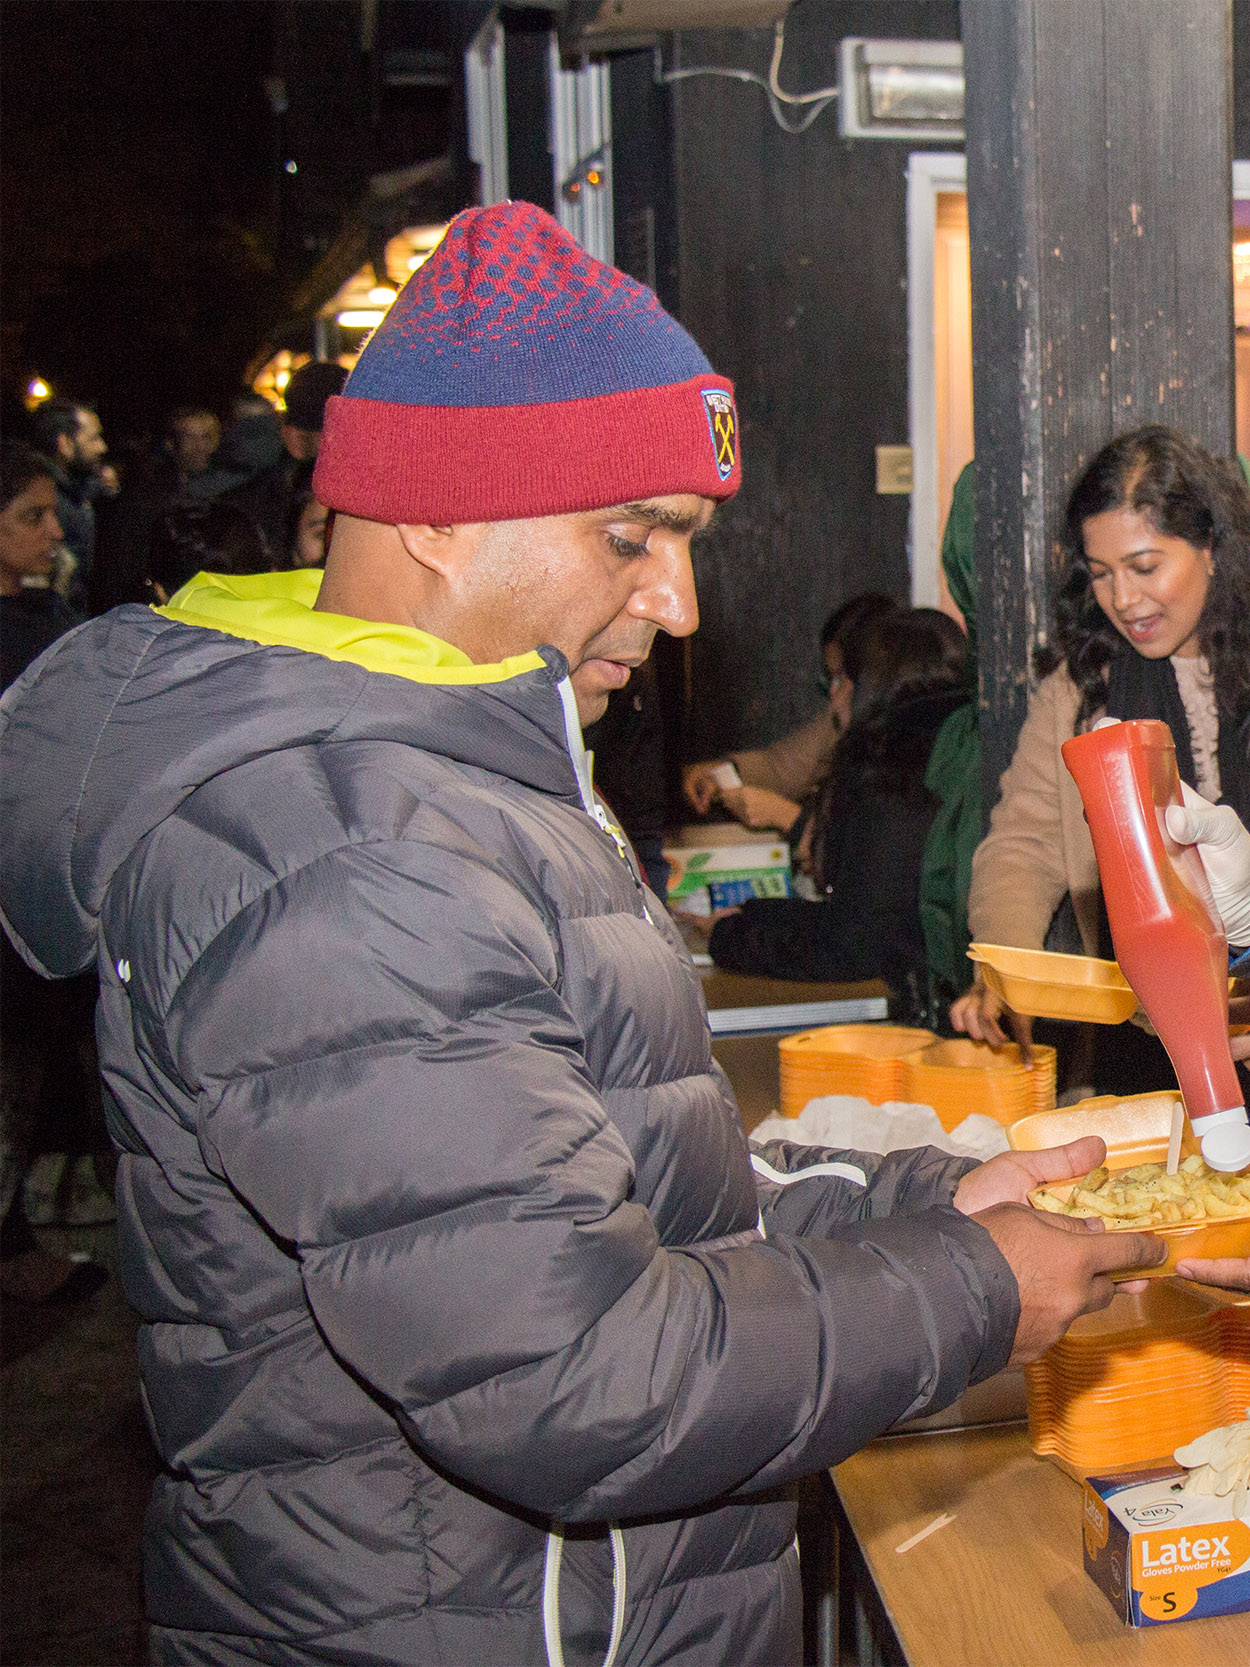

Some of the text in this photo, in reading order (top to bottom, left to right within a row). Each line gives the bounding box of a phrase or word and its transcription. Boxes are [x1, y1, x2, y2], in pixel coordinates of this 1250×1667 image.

[1141, 1507, 1175, 1517] Yala
[1142, 1536, 1231, 1568] Latex
[1142, 1558, 1231, 1577] Gloves Powder Free
[1162, 1592, 1177, 1613] S
